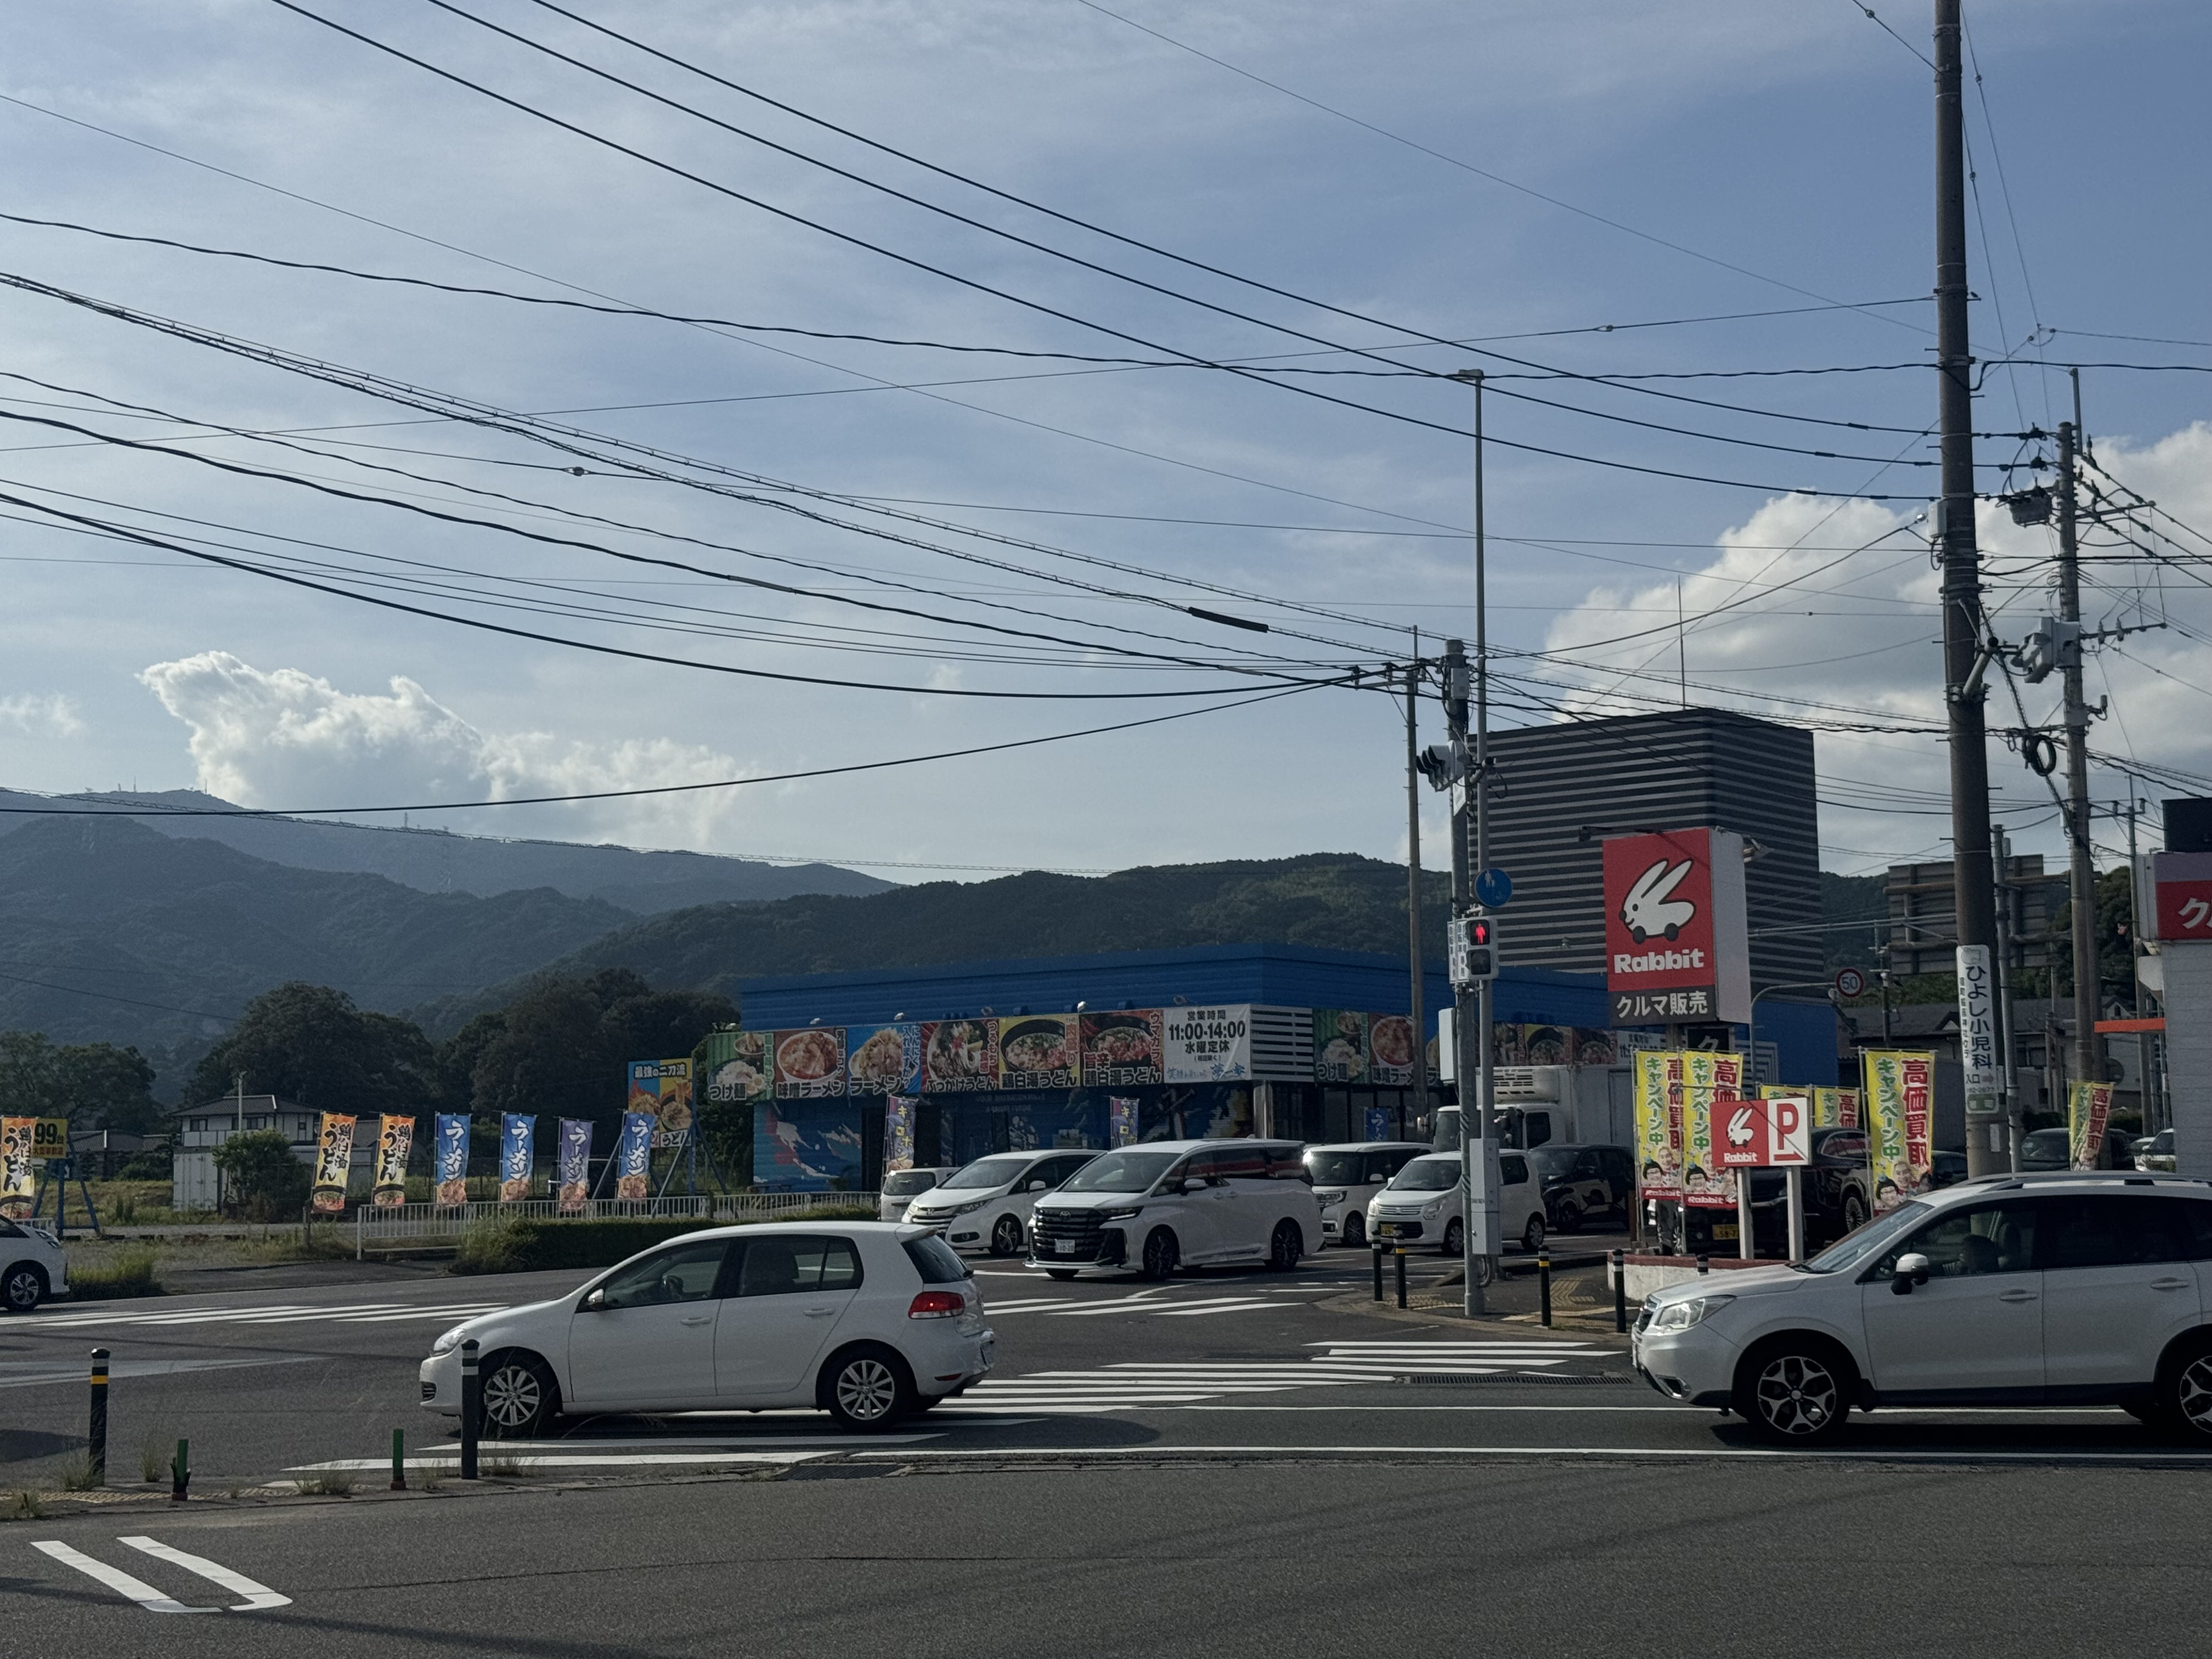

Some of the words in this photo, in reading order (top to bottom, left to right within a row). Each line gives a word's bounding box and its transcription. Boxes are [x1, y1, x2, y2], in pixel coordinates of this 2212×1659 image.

[2178, 898, 2212, 929] ク
[1613, 948, 1705, 974] Rabbit
[1842, 977, 1858, 990] 50
[1187, 1010, 1226, 1021] 営業時間
[1616, 990, 1708, 1019] クルマ販売
[1966, 965, 1992, 1070] ひよし小児科
[911, 1025, 921, 1066] にんにく
[988, 1022, 998, 1066] つるもち
[1150, 1012, 1161, 1061] ウマカラ
[1185, 1040, 1230, 1054] 水曜定休
[635, 1063, 686, 1079] 最強の二刀流
[1084, 1052, 1110, 1071] 旨辛
[1316, 1062, 1348, 1082] つけ麺
[708, 1082, 746, 1100] つけ麺
[776, 1081, 845, 1099] 味噌ラーメン
[849, 1075, 901, 1096] ラーメン
[1001, 1070, 1077, 1089] 鶏白湯うどん
[1084, 1067, 1162, 1087] 鶏白湯うどん
[1966, 1074, 1980, 1084] 入口
[1646, 1057, 1663, 1146] キャンペーン中
[1692, 1057, 1710, 1150] キャンペーン中
[1877, 1058, 1900, 1160] キャンペーン中
[1901, 1059, 1931, 1167] 高価買取
[1776, 1103, 1799, 1150] P
[4, 1127, 22, 1192] うどん
[319, 1122, 338, 1182] うどん
[379, 1125, 397, 1181] うどん
[441, 1120, 465, 1181] ラーメン
[507, 1120, 529, 1180] ラーメン
[565, 1126, 588, 1184] ラーメン
[627, 1118, 650, 1176] ラーメン
[1724, 1152, 1758, 1163] Rabbit
[1688, 1195, 1724, 1204] Rabbit
[1719, 1229, 1739, 1238] 58-7
